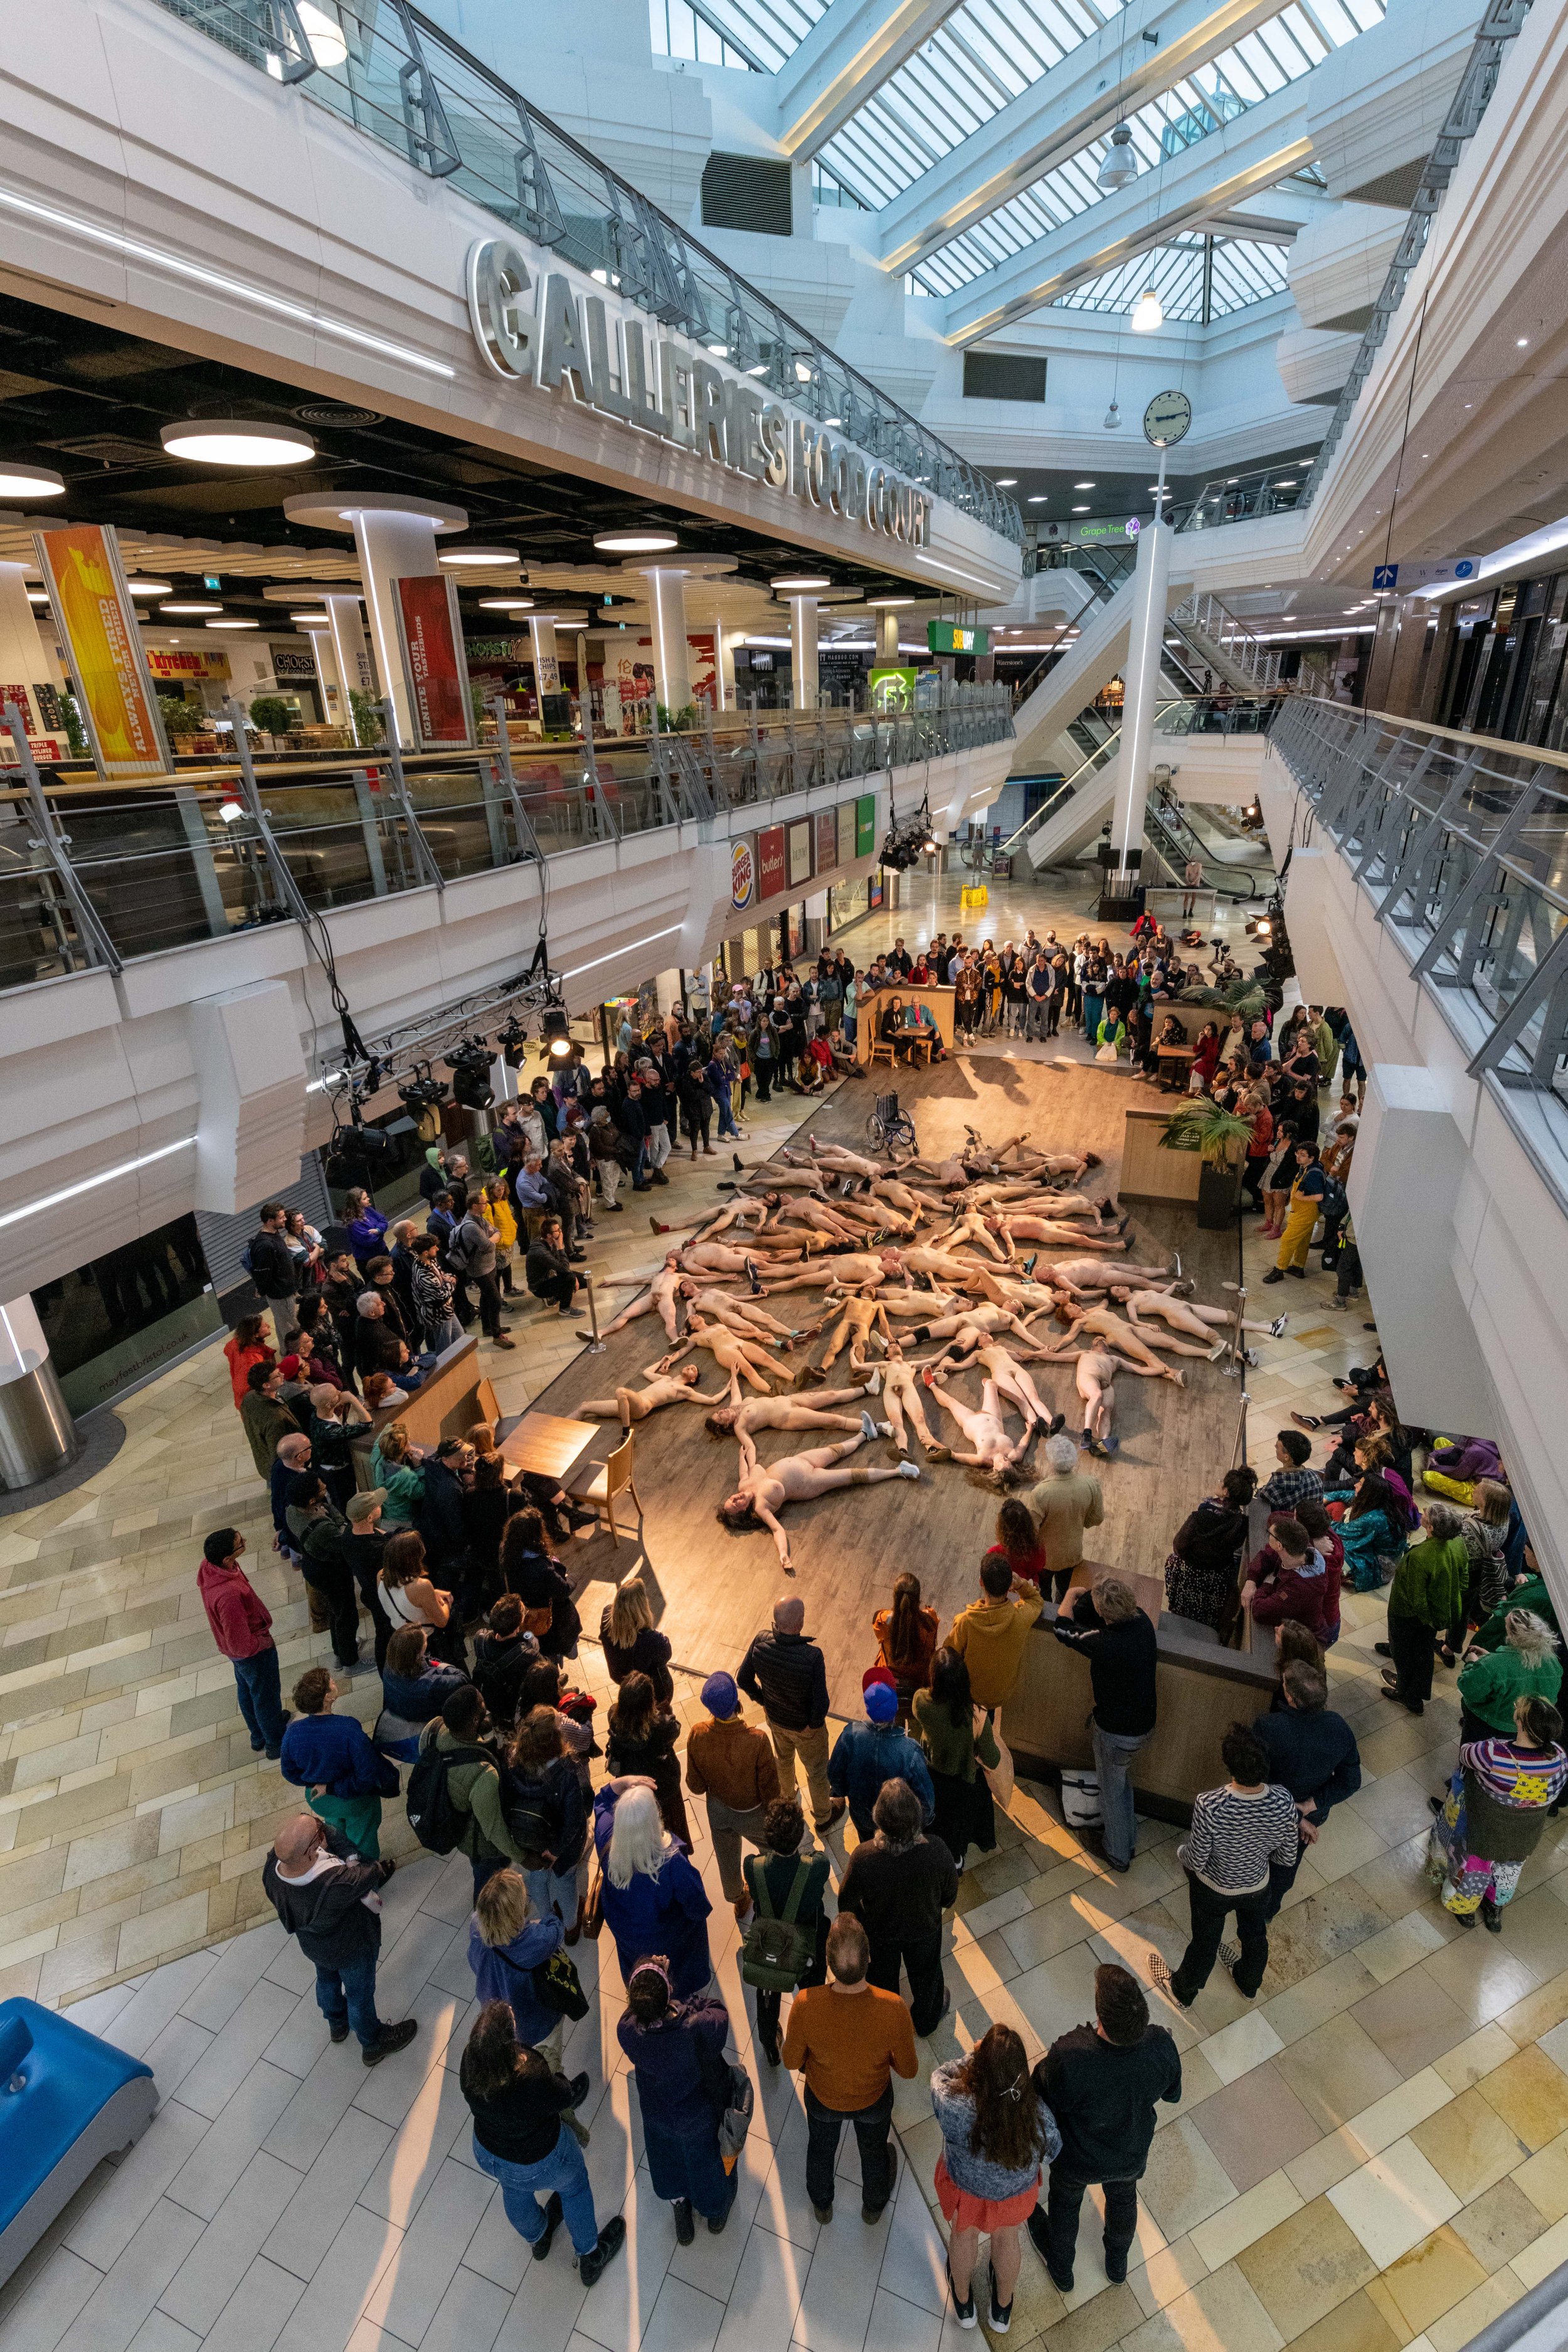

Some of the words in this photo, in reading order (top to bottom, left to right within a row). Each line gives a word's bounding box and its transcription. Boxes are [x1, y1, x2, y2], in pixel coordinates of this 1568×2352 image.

[466, 239, 788, 487] GALLERIES
[788, 419, 867, 519] FOOD
[867, 465, 934, 549] COURT
[1081, 526, 1106, 537] Grape
[1108, 524, 1125, 533] Tree
[98, 598, 122, 664] FIRED
[109, 600, 126, 646] FRIED
[953, 628, 975, 650] SUBWAY
[154, 655, 201, 669] KITCHEN
[411, 640, 424, 682] YOUR
[415, 615, 429, 678] TASTEBUDS
[122, 650, 140, 698] NEVER
[117, 670, 147, 753] ALWAYS
[418, 686, 432, 737] IGNITE
[732, 851, 750, 881] BURGER
[733, 862, 751, 899] KING
[761, 852, 783, 874] butler's
[98, 1332, 190, 1392] mayfestbristol.co.uk
